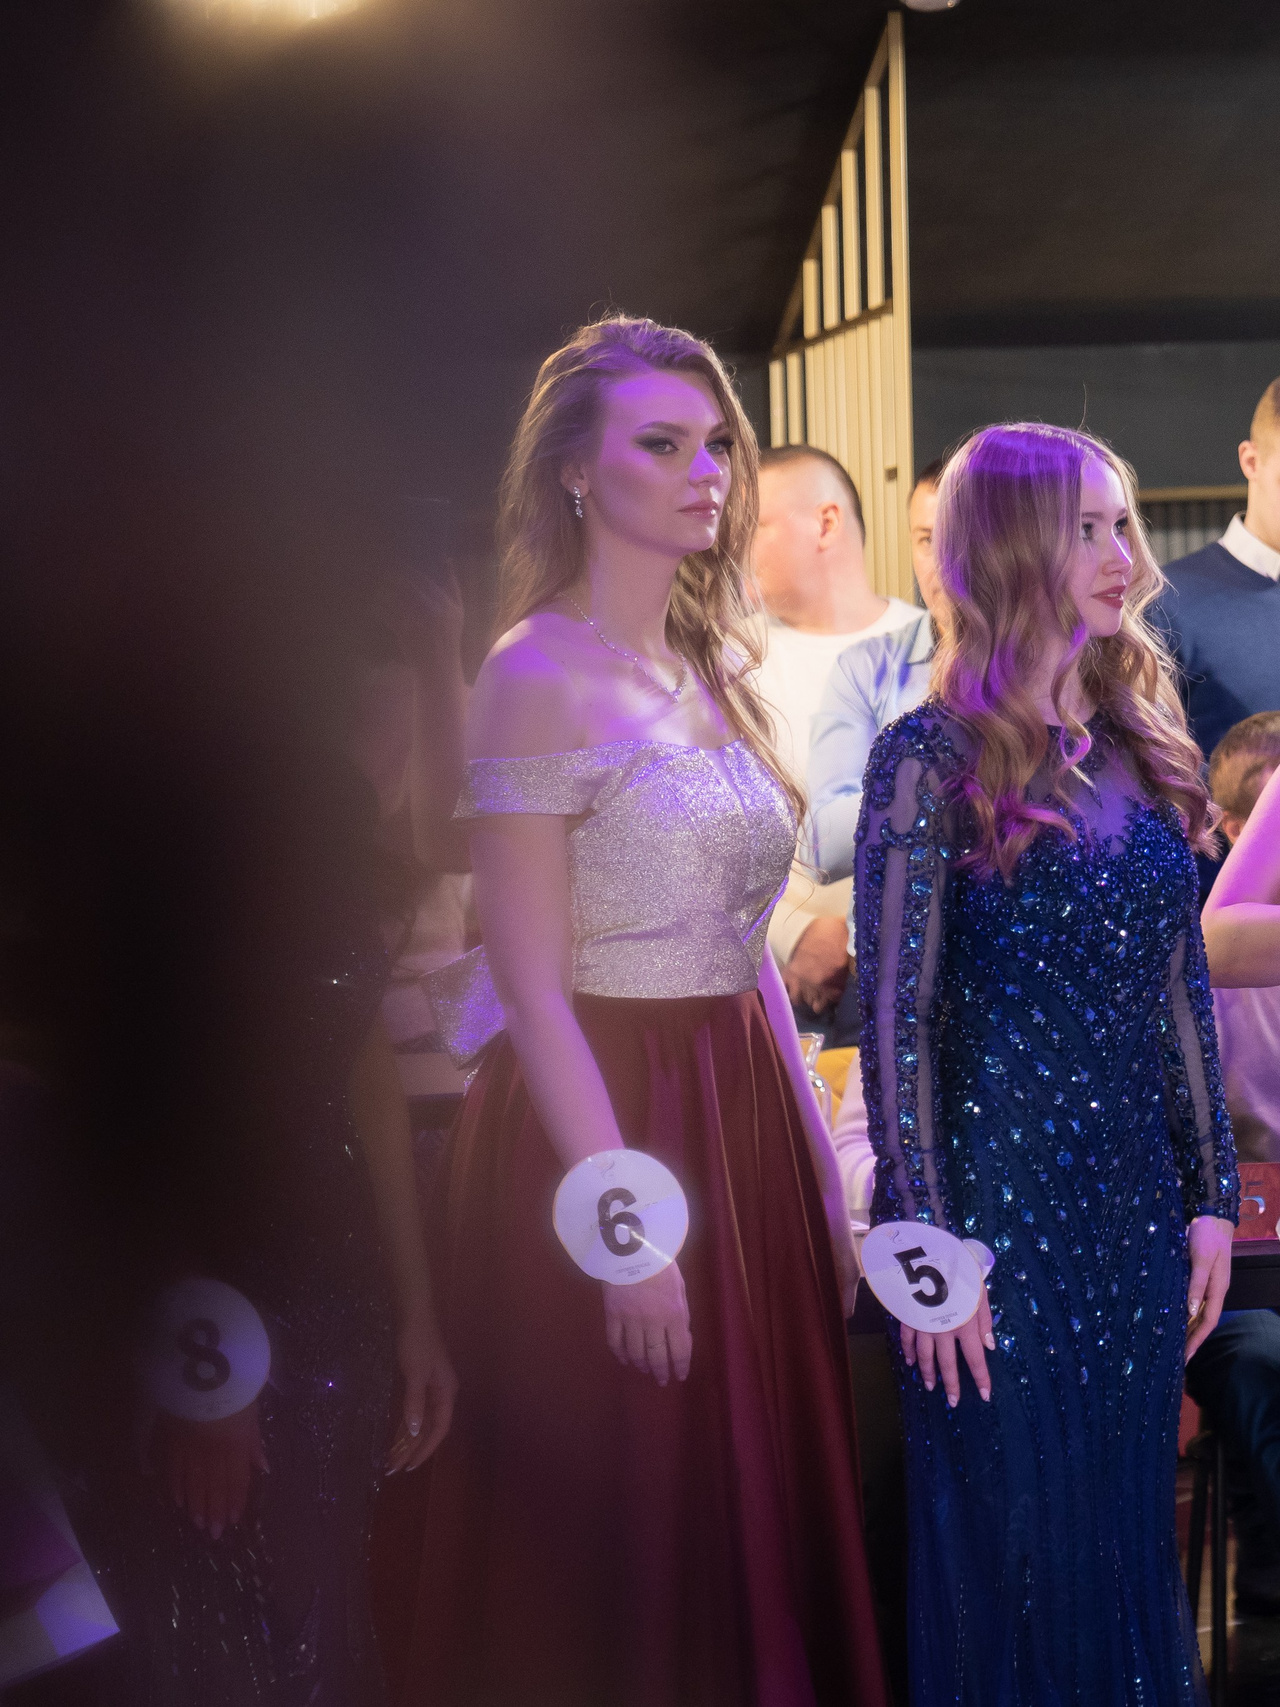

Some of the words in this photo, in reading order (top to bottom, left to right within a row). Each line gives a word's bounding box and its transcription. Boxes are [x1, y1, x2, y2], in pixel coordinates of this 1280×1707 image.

[597, 1187, 645, 1256] 6
[1243, 1181, 1266, 1220] 5
[893, 1246, 948, 1308] 5
[177, 1318, 231, 1392] 8
